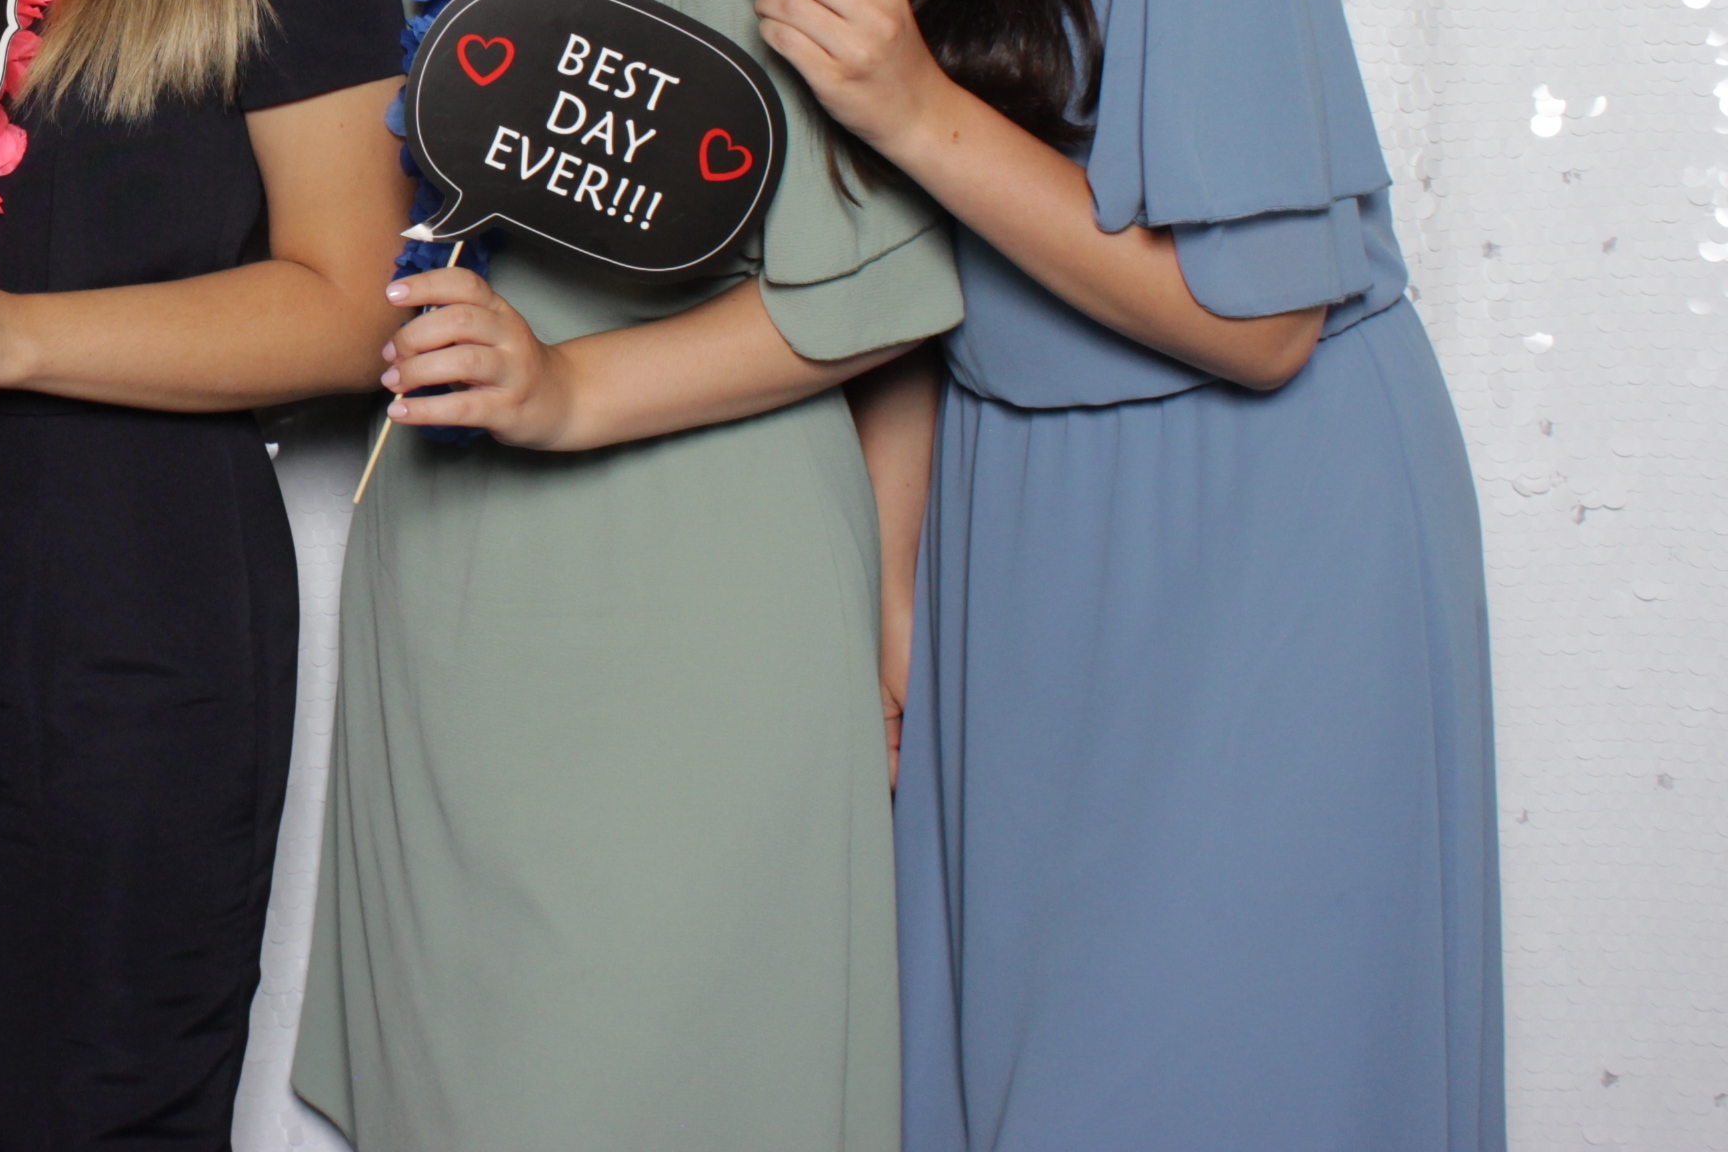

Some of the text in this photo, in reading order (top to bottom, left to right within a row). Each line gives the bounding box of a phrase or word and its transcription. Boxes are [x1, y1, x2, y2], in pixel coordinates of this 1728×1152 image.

[557, 33, 680, 111] BEST
[545, 90, 657, 164] DAY
[484, 125, 663, 230] EVER!!!
